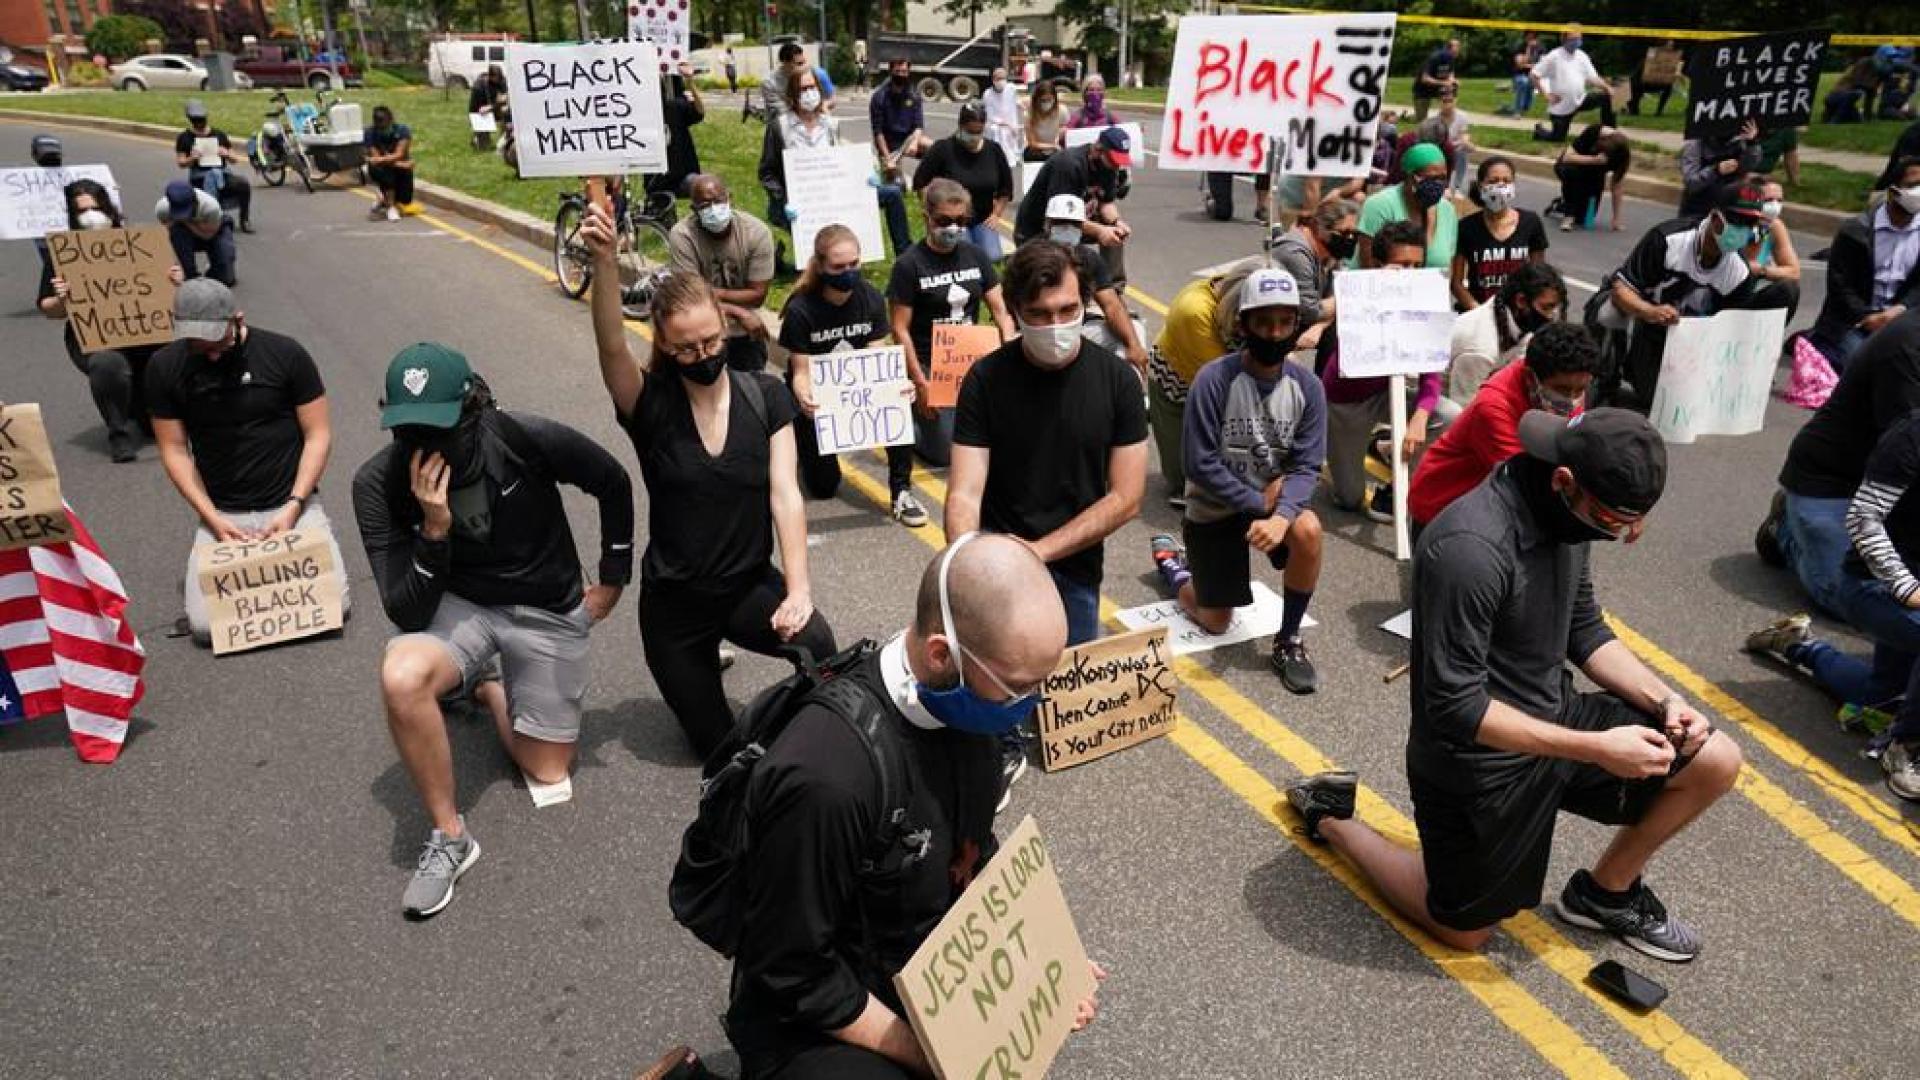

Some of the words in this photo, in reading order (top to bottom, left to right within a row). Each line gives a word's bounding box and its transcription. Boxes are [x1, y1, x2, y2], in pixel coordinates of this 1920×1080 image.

[1716, 42, 1824, 67] BLACK
[523, 56, 641, 92] BLACK
[1195, 38, 1346, 108] Black
[1725, 64, 1810, 88] LIVES
[544, 93, 632, 119] LIVES
[1694, 88, 1811, 123] MATTER
[535, 124, 647, 155] MATTER
[1172, 108, 1264, 169] Lives
[50, 230, 153, 266] Black
[67, 272, 153, 305] Lives
[934, 330, 955, 346] No
[814, 352, 905, 386] JUSTICE
[841, 388, 872, 408] FOR
[816, 407, 905, 449] FLOYD
[211, 534, 302, 564] STOP
[213, 556, 319, 600] KILLING
[235, 583, 317, 620] BLACK
[228, 607, 326, 647] PEOPLE
[920, 912, 989, 1019] JESUS
[981, 885, 1009, 923] IS
[1001, 836, 1046, 900] LORD
[971, 919, 1029, 1023] NOT
